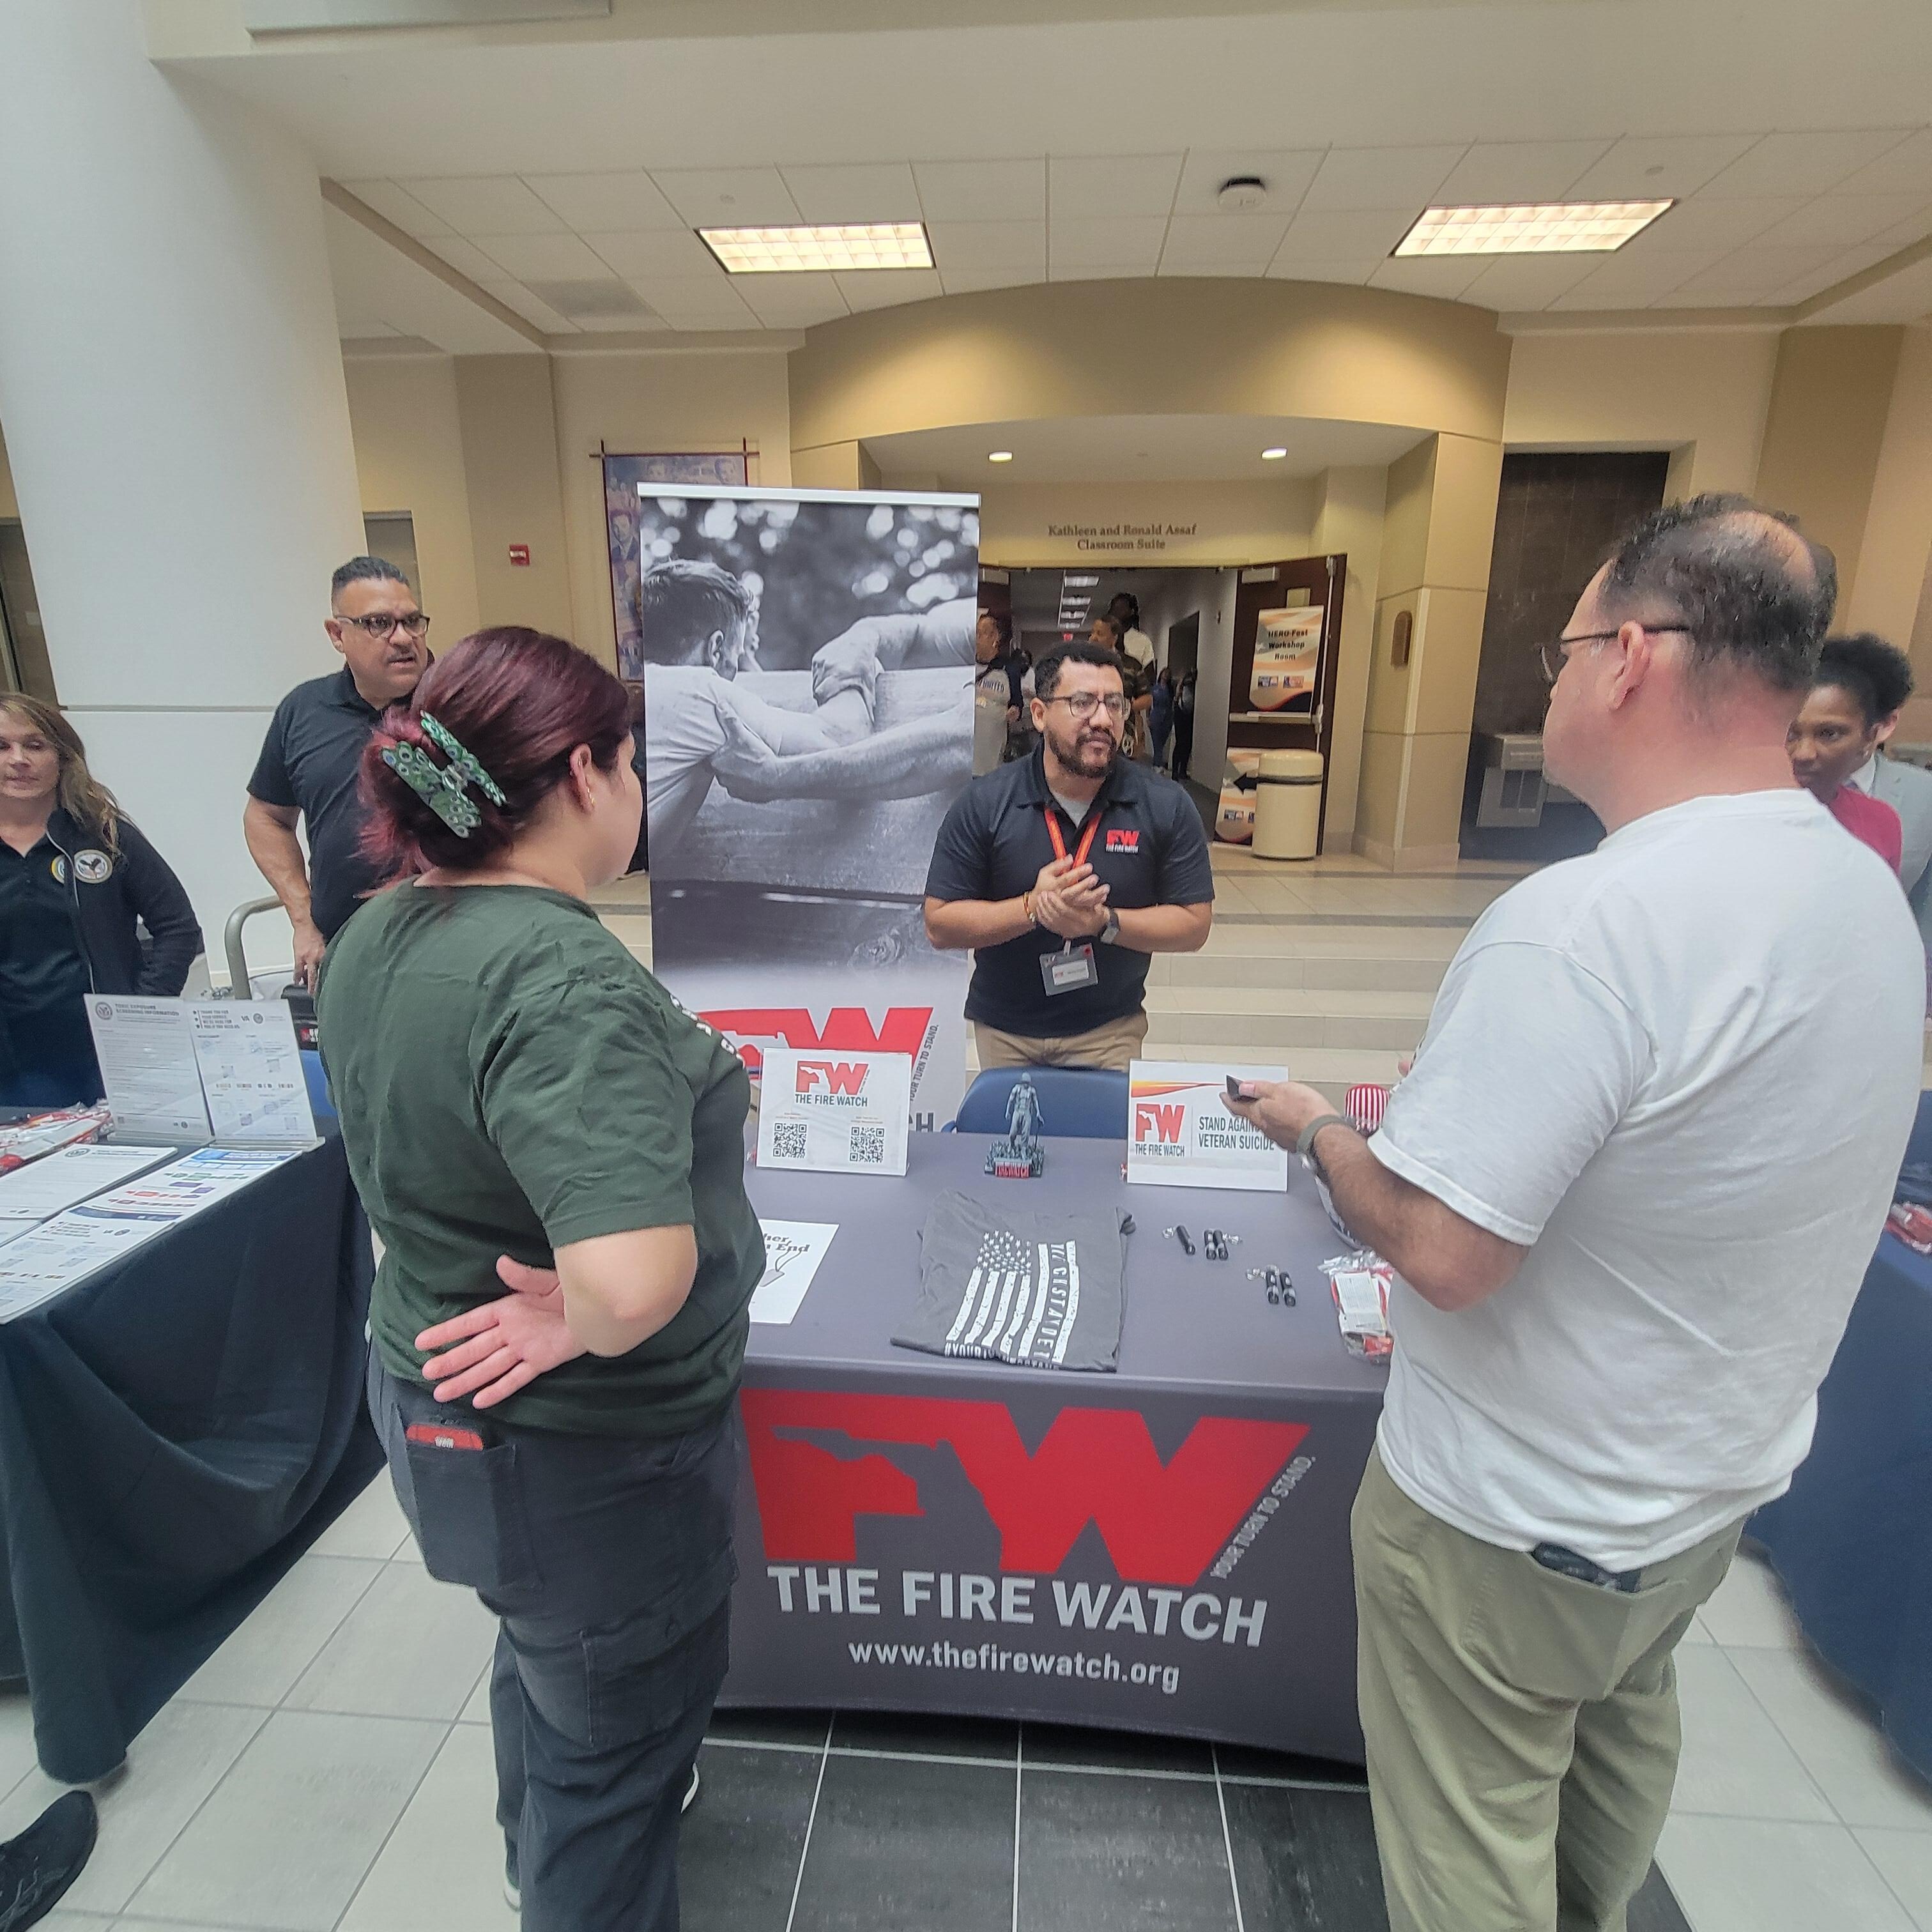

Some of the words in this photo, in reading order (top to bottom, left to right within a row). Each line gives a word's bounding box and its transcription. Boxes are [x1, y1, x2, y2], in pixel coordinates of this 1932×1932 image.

[1048, 525, 1097, 537] Kathleen
[1100, 525, 1120, 536] and
[1123, 524, 1162, 536] Ronald
[1165, 523, 1197, 535] Assaf
[1077, 539, 1135, 551] Classroom
[1137, 539, 1166, 550] Suite
[1268, 640, 1305, 650] Workshop
[1107, 829, 1140, 845] FW
[924, 1024, 939, 1050] STAND.
[920, 1050, 930, 1061] TO
[795, 1060, 869, 1096] FW
[913, 1061, 927, 1081] TURN
[795, 1093, 811, 1104] THE
[815, 1094, 834, 1105] FIRE
[837, 1096, 868, 1107] WATCH
[1135, 1103, 1185, 1144] FW
[1198, 1116, 1226, 1131] STAND
[1135, 1143, 1147, 1155] THE
[1148, 1144, 1162, 1156] FIRE
[1163, 1144, 1185, 1158] WATCH
[1198, 1133, 1236, 1149] VETERAN
[1239, 1135, 1275, 1151] SUICIDE
[775, 1243, 811, 1252] End
[739, 1387, 1312, 1587] FW
[1232, 1512, 1269, 1547] TURN
[1256, 1496, 1280, 1515] TO
[766, 1565, 881, 1616] THE
[901, 1569, 1036, 1625] FIRE
[1051, 1579, 1268, 1648] WATCH
[848, 1641, 1181, 1696] www.thefirewatch.org
